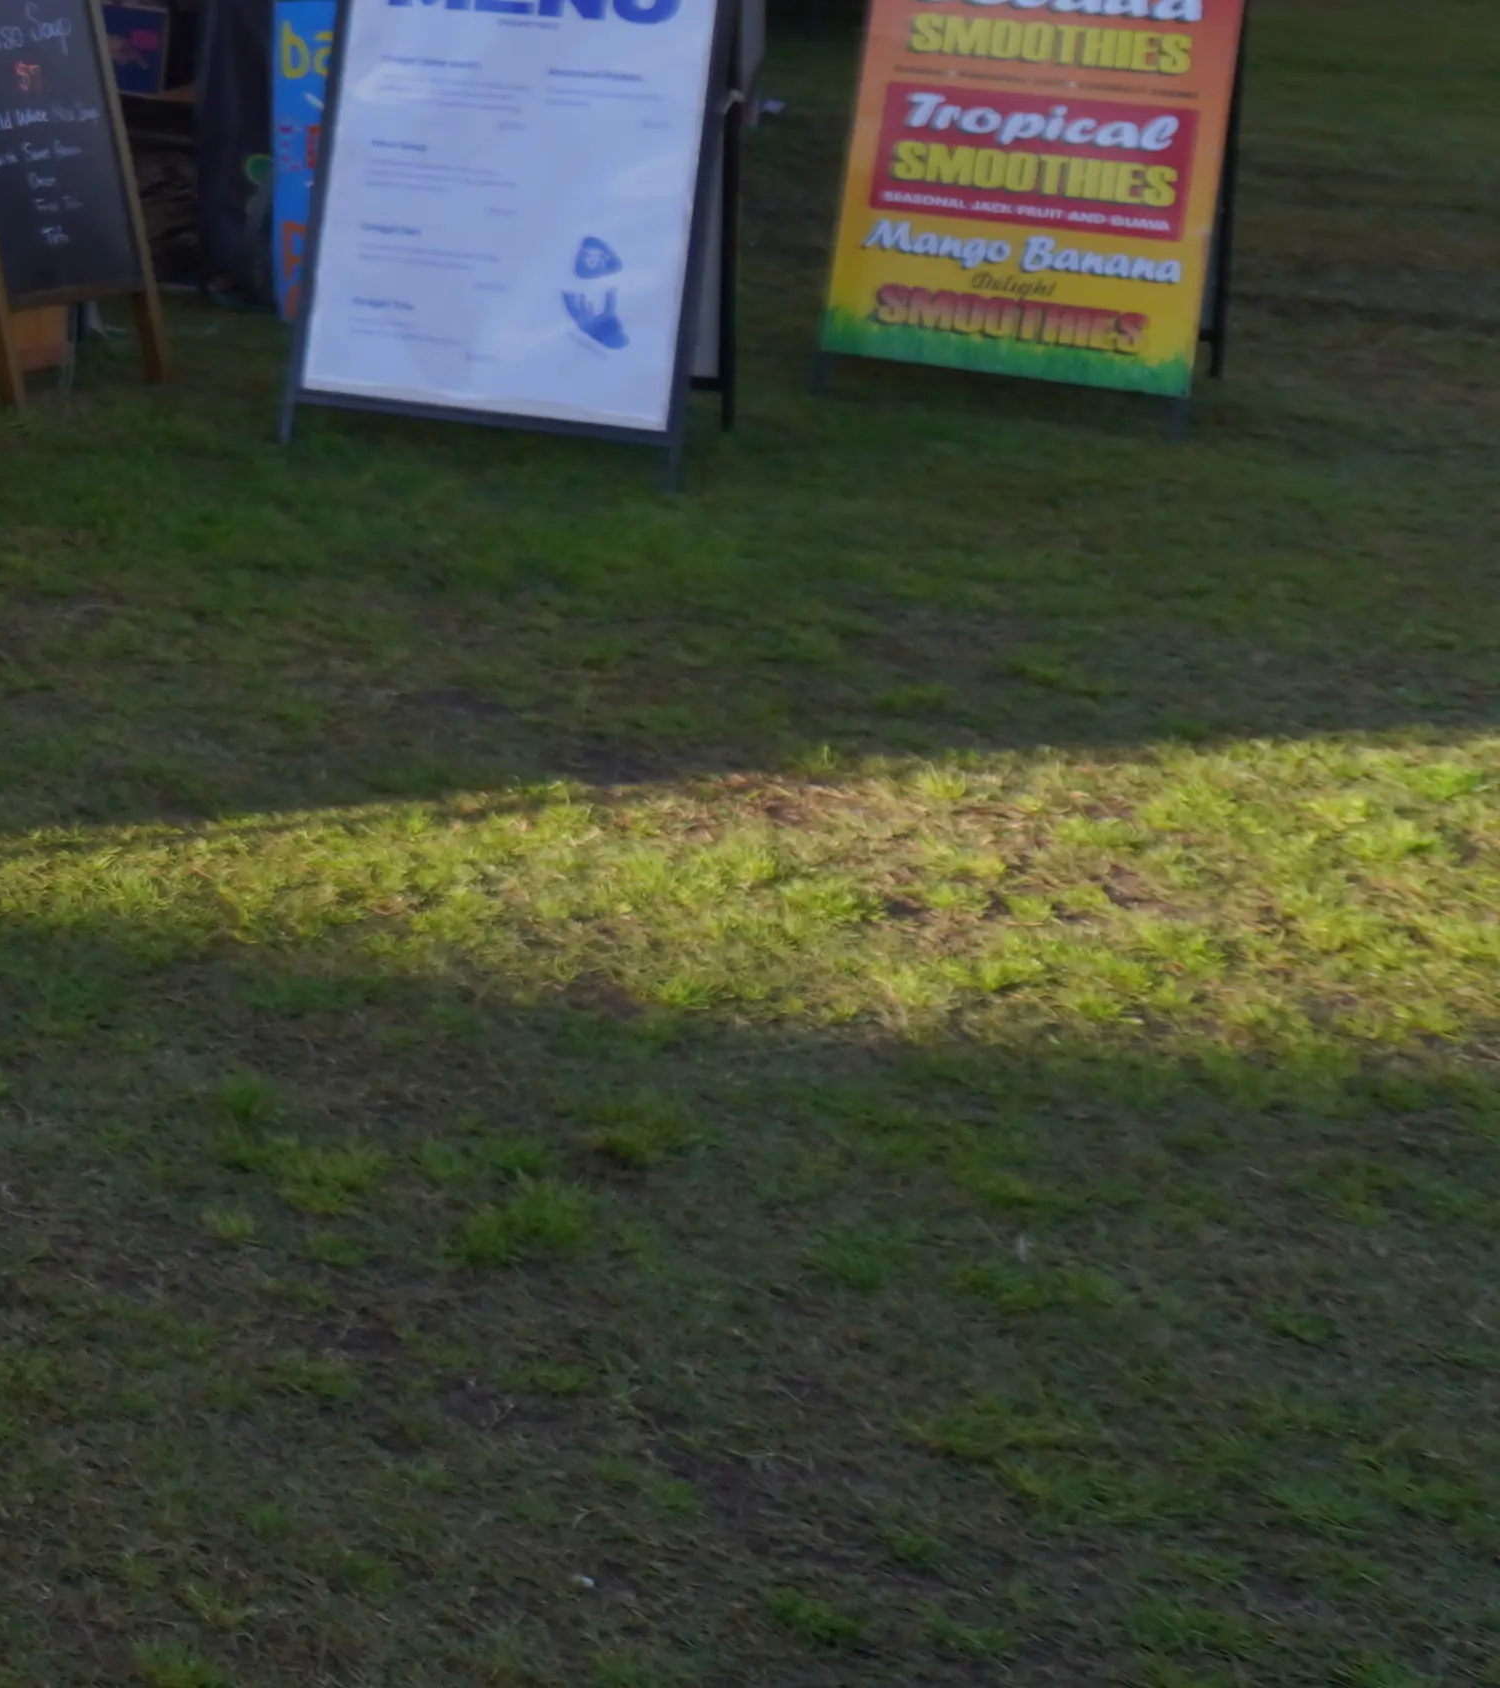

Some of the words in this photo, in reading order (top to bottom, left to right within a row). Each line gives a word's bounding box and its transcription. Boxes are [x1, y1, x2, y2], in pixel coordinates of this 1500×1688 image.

[25, 2, 72, 55] Soup
[908, 13, 1193, 76] SMOOTHIES
[905, 92, 1179, 153] Tropical
[891, 141, 1179, 209] SMOOTHIES
[883, 190, 967, 211] SEASONAL
[970, 200, 1013, 215] JACK
[1016, 204, 1063, 220] FRUIT
[1067, 210, 1106, 225] AND
[864, 219, 1011, 269] Mango
[1022, 235, 1182, 285] Banana
[871, 283, 1152, 353] SMOOTHIES
